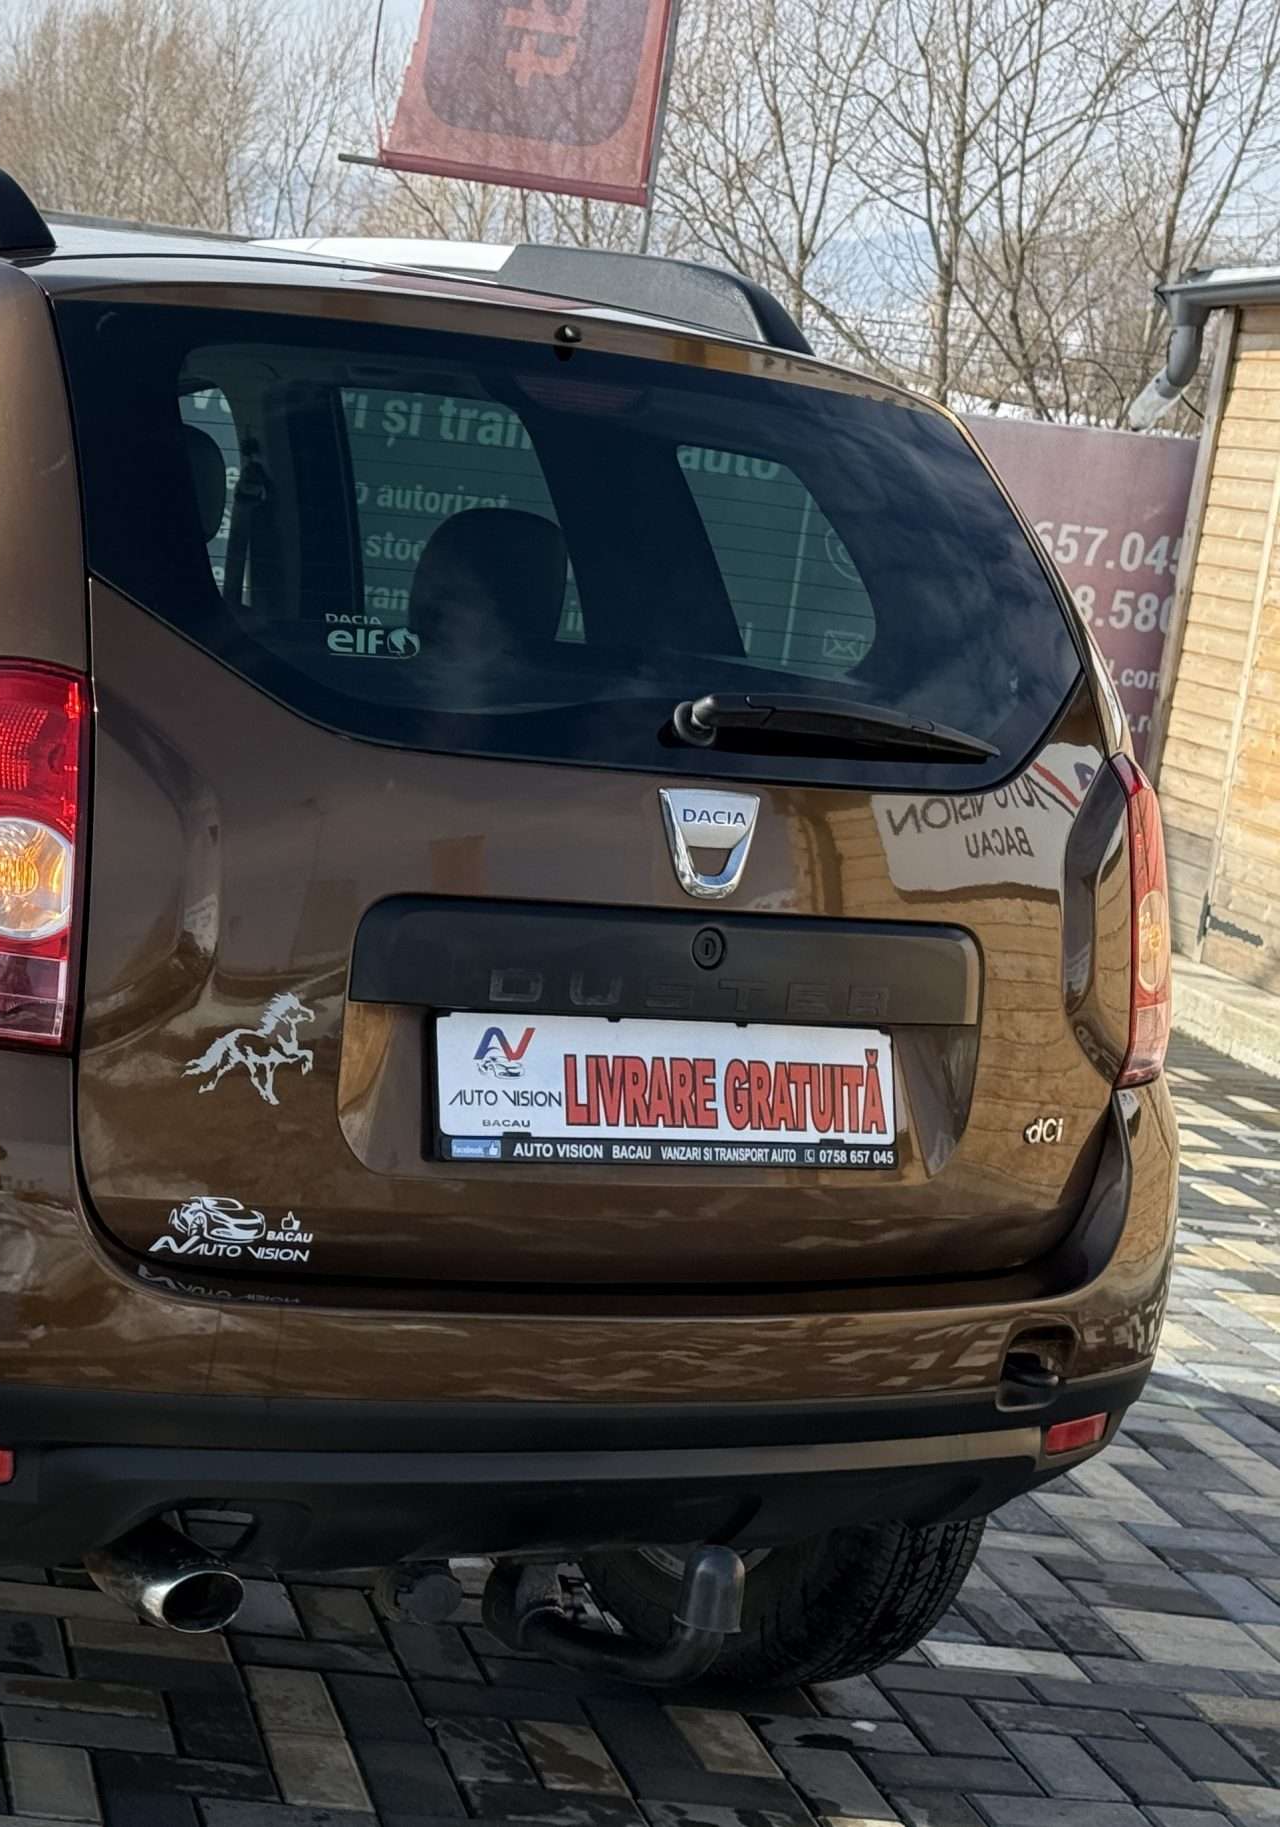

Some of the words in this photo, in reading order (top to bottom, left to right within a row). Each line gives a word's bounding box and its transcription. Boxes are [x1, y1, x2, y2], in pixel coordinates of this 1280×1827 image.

[324, 612, 382, 626] DACIA
[327, 628, 385, 655] elf
[682, 808, 747, 826] DACIA
[489, 968, 889, 1017] DUSTER
[448, 1089, 498, 1107] AUTO
[502, 1090, 563, 1108] VISION
[563, 1053, 719, 1129] LIVRARE
[723, 1048, 888, 1135] GRATUITĂ
[482, 1119, 531, 1129] BACAU
[1024, 1117, 1064, 1144] dCi
[513, 1142, 555, 1158] AUTO
[556, 1143, 603, 1159] VISION
[612, 1145, 651, 1160] BACAU
[660, 1146, 701, 1161] VANZARI
[703, 1147, 712, 1161] SI
[713, 1148, 769, 1162] TRANSPORT
[771, 1149, 797, 1163] AUTO
[819, 1149, 847, 1163] 0758
[850, 1150, 870, 1164] 657
[873, 1151, 894, 1165] 045
[266, 1230, 314, 1243] BACAU
[186, 1242, 242, 1258] AUTO
[247, 1245, 310, 1262] VISION
